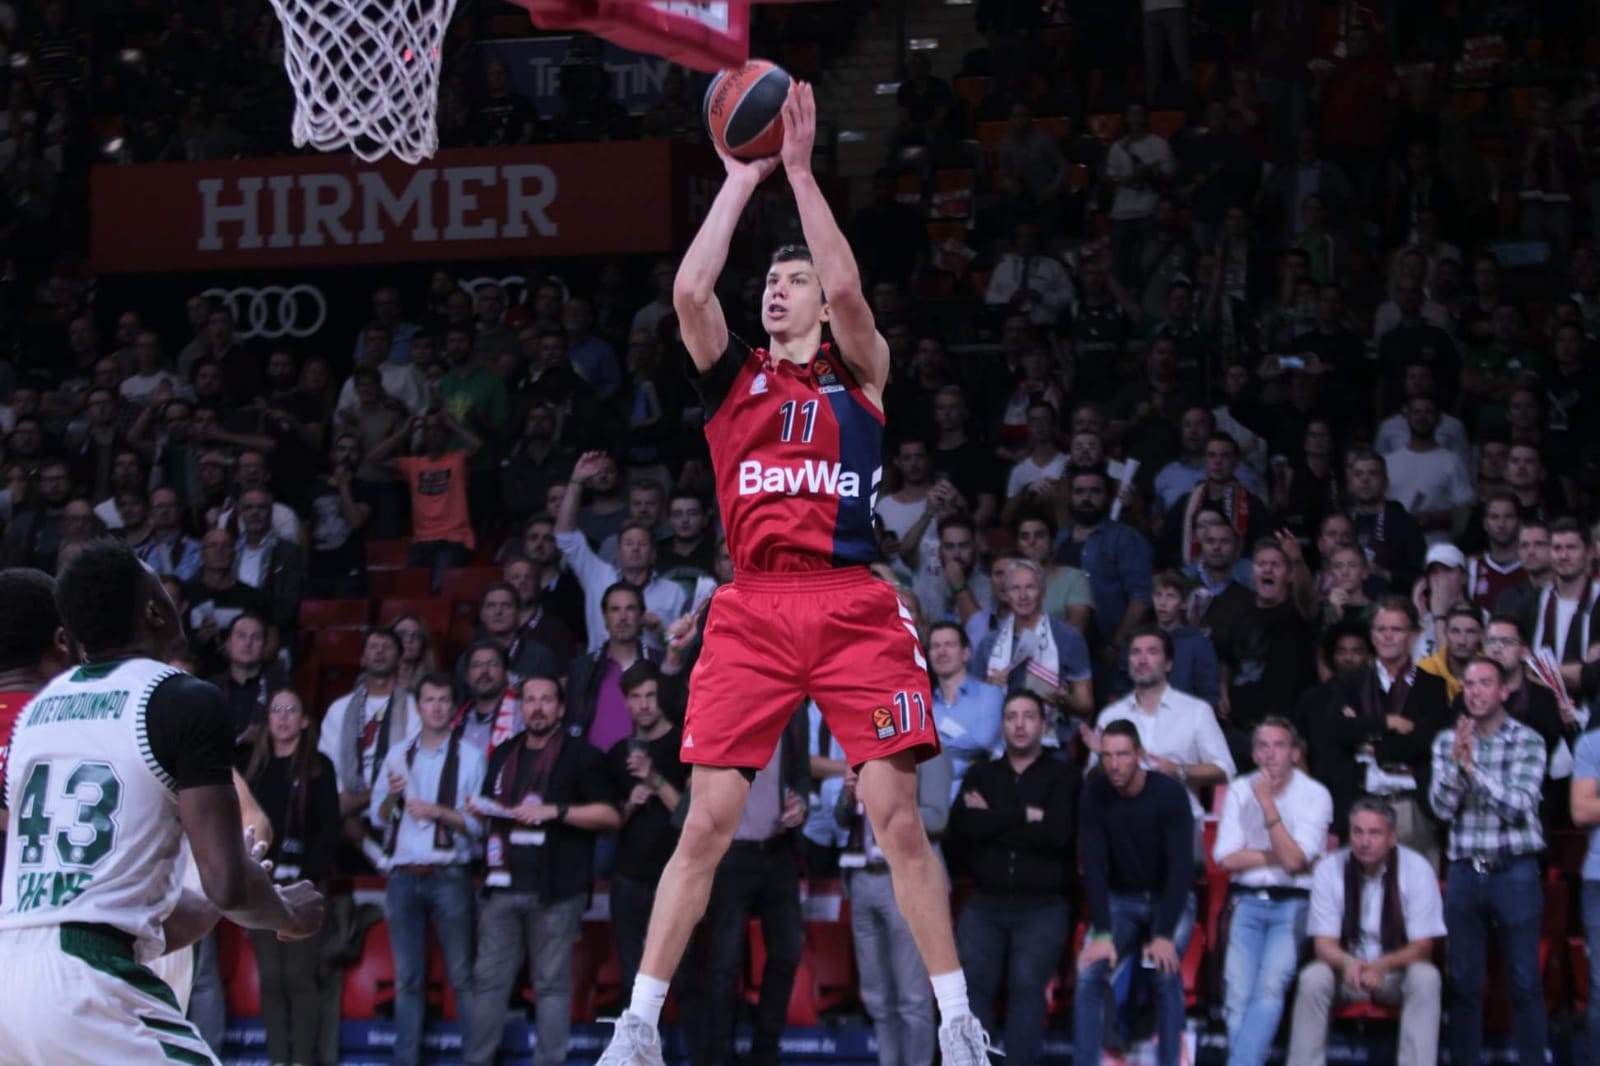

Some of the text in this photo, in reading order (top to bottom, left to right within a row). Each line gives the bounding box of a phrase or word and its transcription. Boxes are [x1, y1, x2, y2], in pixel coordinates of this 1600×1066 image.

[197, 164, 559, 251] HIRMER
[780, 400, 819, 443] 11
[739, 459, 860, 497] BayWa
[893, 690, 926, 734] 11
[17, 761, 124, 868] 43
